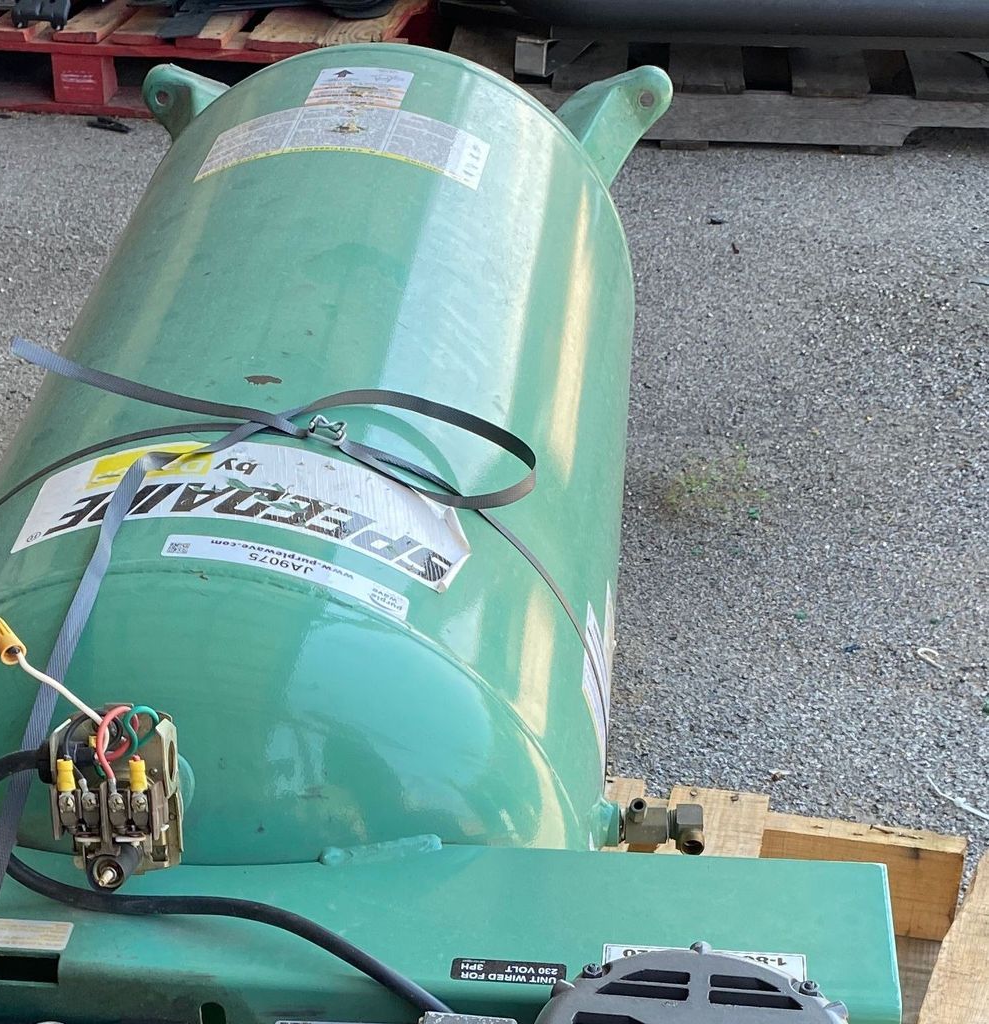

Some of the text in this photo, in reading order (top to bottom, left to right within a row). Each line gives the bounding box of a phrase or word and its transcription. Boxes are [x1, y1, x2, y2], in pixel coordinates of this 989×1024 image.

[214, 457, 259, 475] by
[210, 539, 354, 580] www.purplewave.com
[248, 552, 314, 575] JA9075
[369, 592, 403, 612] purple
[372, 587, 399, 603] wave
[460, 962, 558, 975] 230 VOLT 3PH
[460, 971, 557, 985] UNIT WIRED FOR
